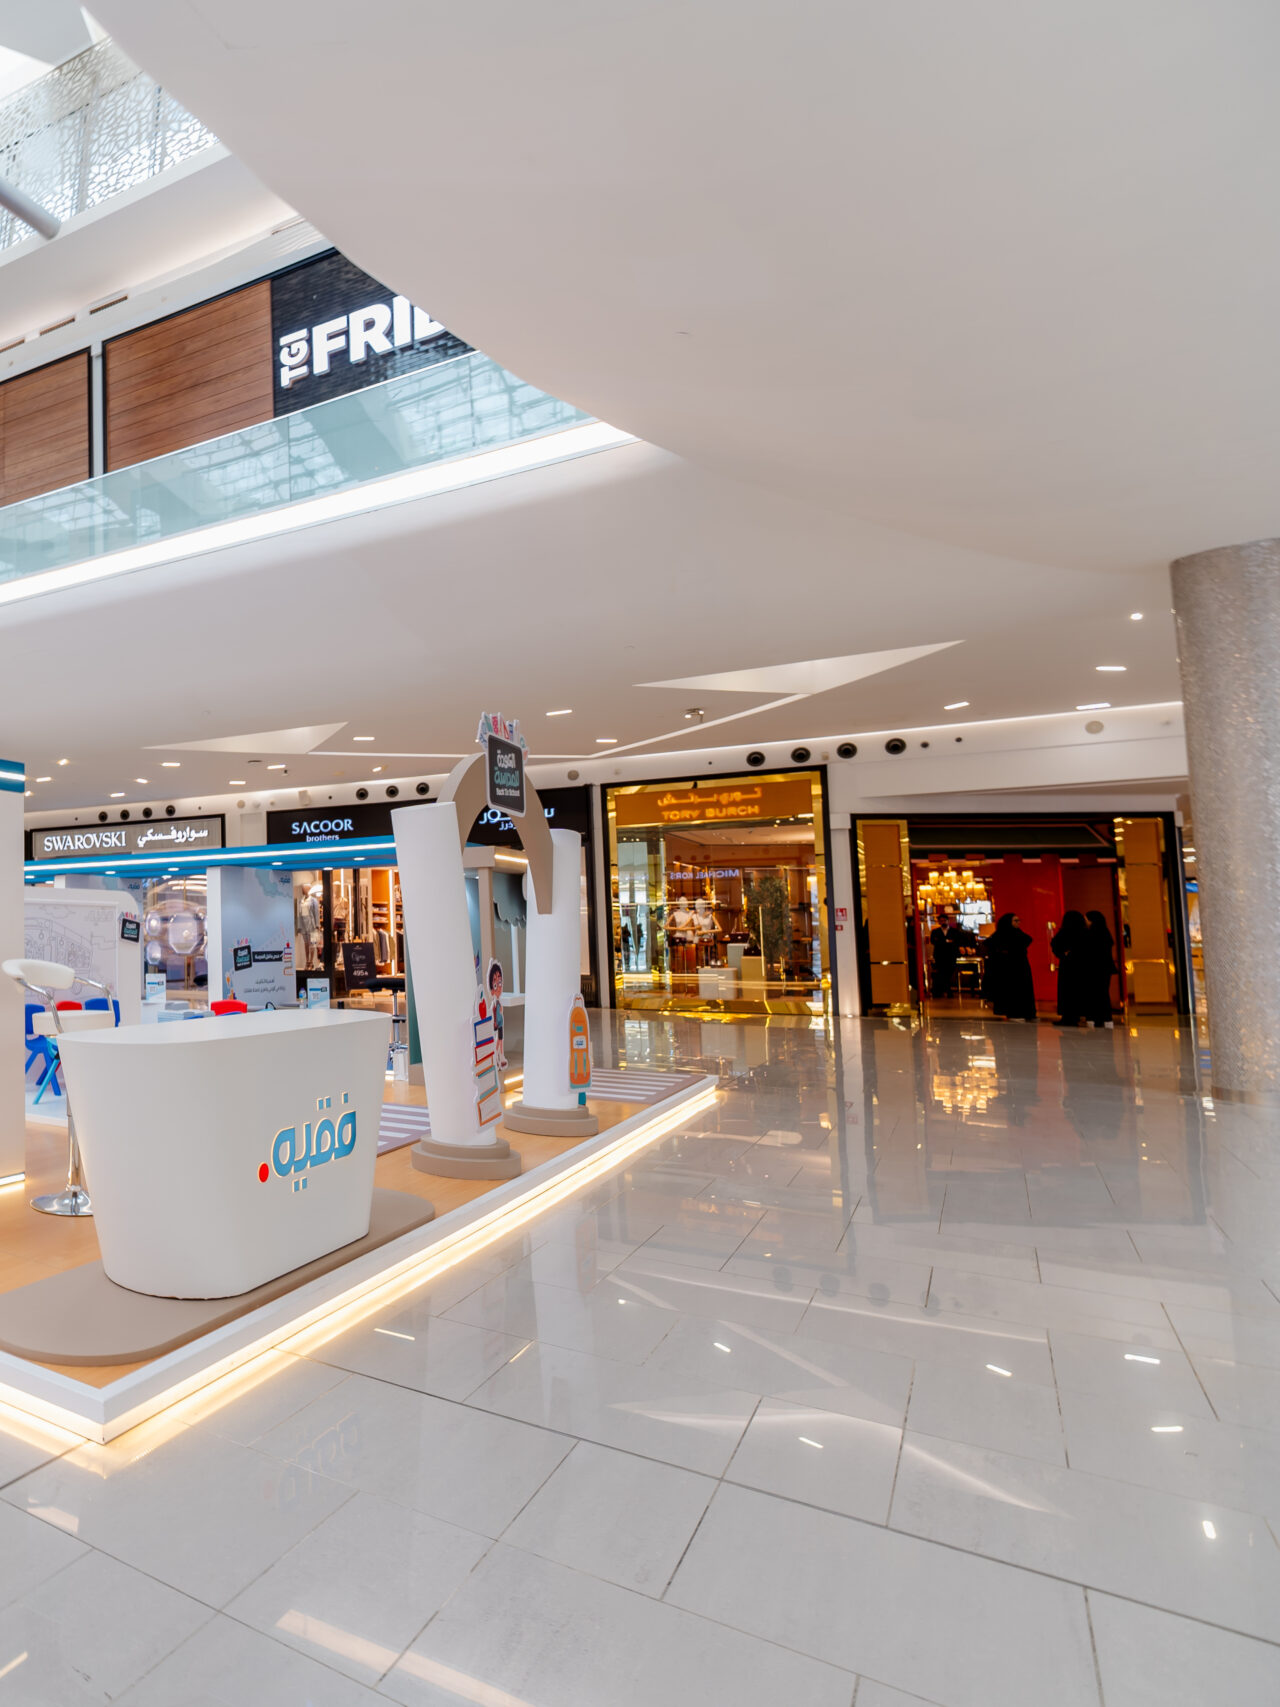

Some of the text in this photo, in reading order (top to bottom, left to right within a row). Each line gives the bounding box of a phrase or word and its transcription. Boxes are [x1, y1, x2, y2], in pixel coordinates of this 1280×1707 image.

[279, 327, 309, 389] TGI
[661, 805, 760, 820] TORY BURCH
[136, 825, 209, 848] سواروفسكي
[291, 818, 354, 835] SACOOR
[44, 831, 126, 852] SWAROVSKI
[306, 833, 340, 842] brothers
[271, 1092, 356, 1192] فقيه
